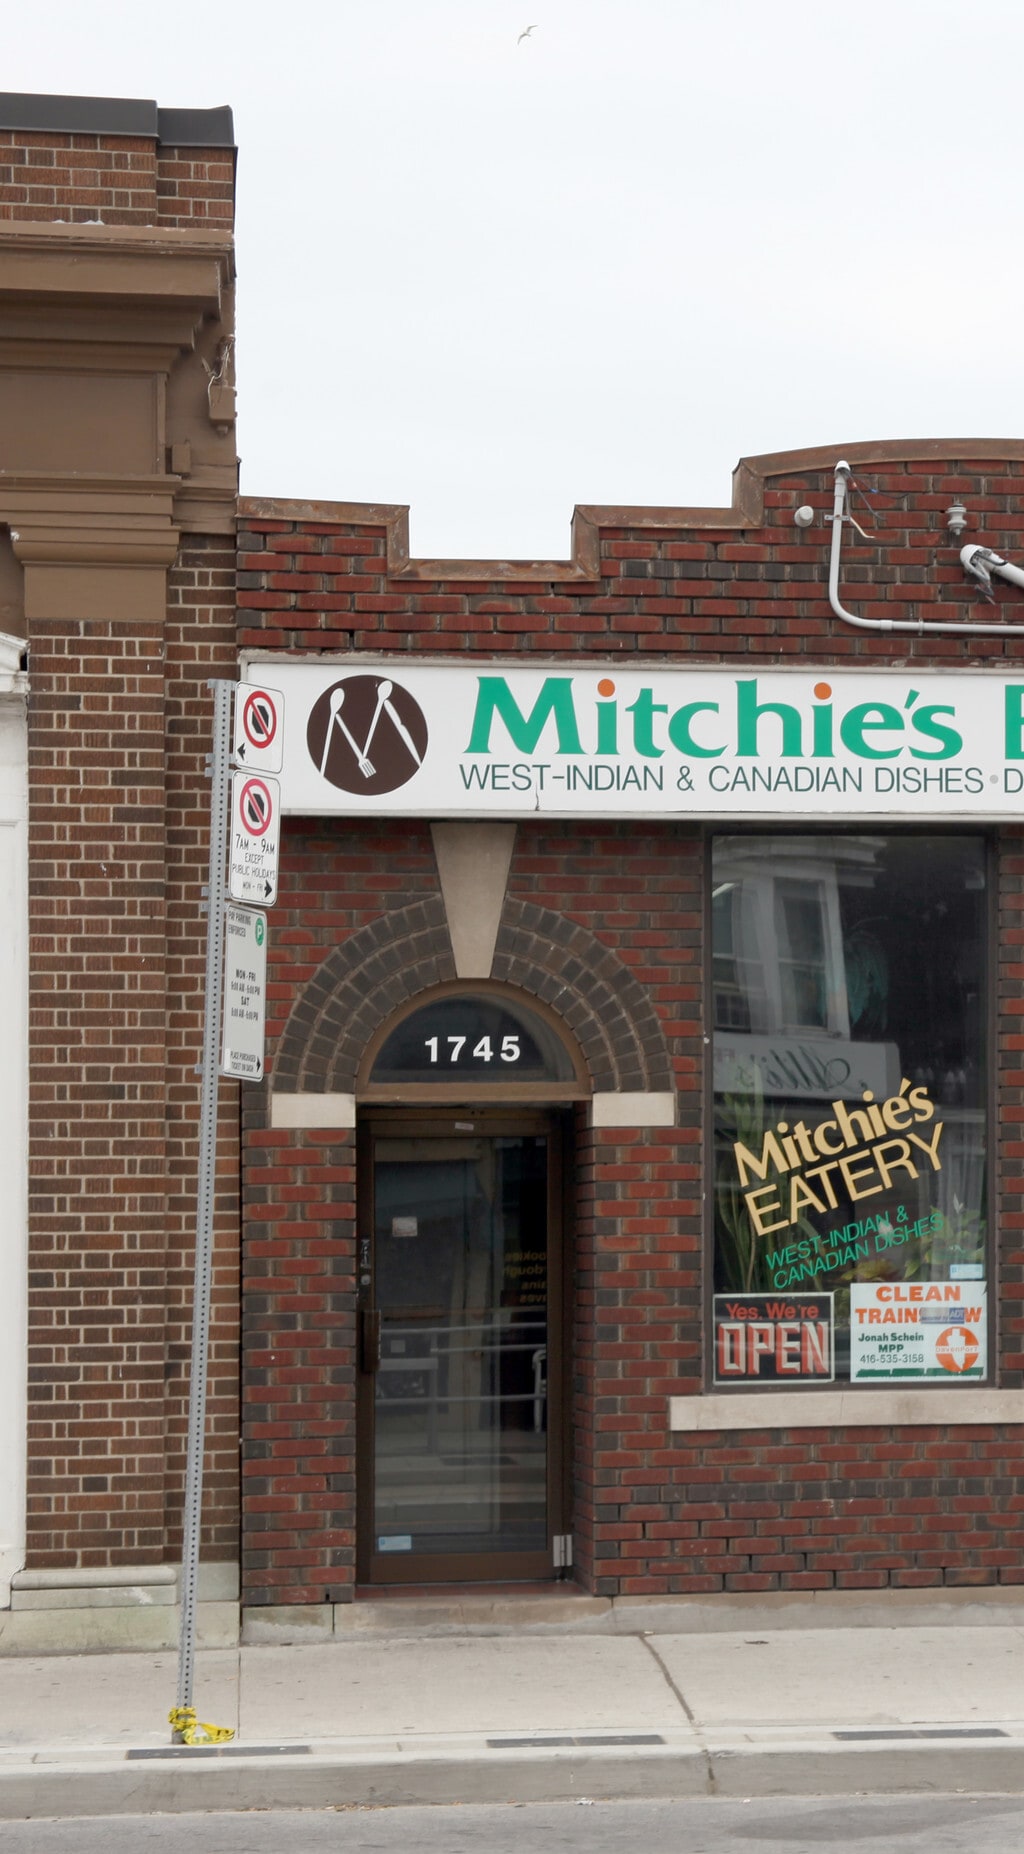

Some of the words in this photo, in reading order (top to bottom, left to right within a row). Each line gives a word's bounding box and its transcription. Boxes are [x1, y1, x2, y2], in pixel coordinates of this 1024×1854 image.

[463, 676, 964, 760] Mitchie's
[459, 764, 665, 791] WEST-INDIAN
[677, 765, 695, 792] &
[708, 765, 863, 794] CANADIAN
[875, 767, 984, 794] DISHES
[232, 863, 250, 876] PUBLIC
[244, 852, 265, 865] EXCEPT
[424, 1035, 521, 1063] 1745
[733, 1077, 936, 1188] Mitchie's
[744, 1121, 944, 1237] EATERY
[765, 1211, 891, 1270] WEST-INDIAN
[896, 1204, 909, 1223] &
[773, 1241, 869, 1289] CANADIAN
[875, 1212, 945, 1254] DISHES
[876, 1285, 961, 1303] CLEAN
[855, 1307, 922, 1324] TRAIN
[717, 1321, 829, 1375] OPEN
[858, 1333, 888, 1342] Jonah
[890, 1332, 924, 1342] Schein
[878, 1344, 904, 1353] MPP
[860, 1353, 924, 1363] 416-535-3158
